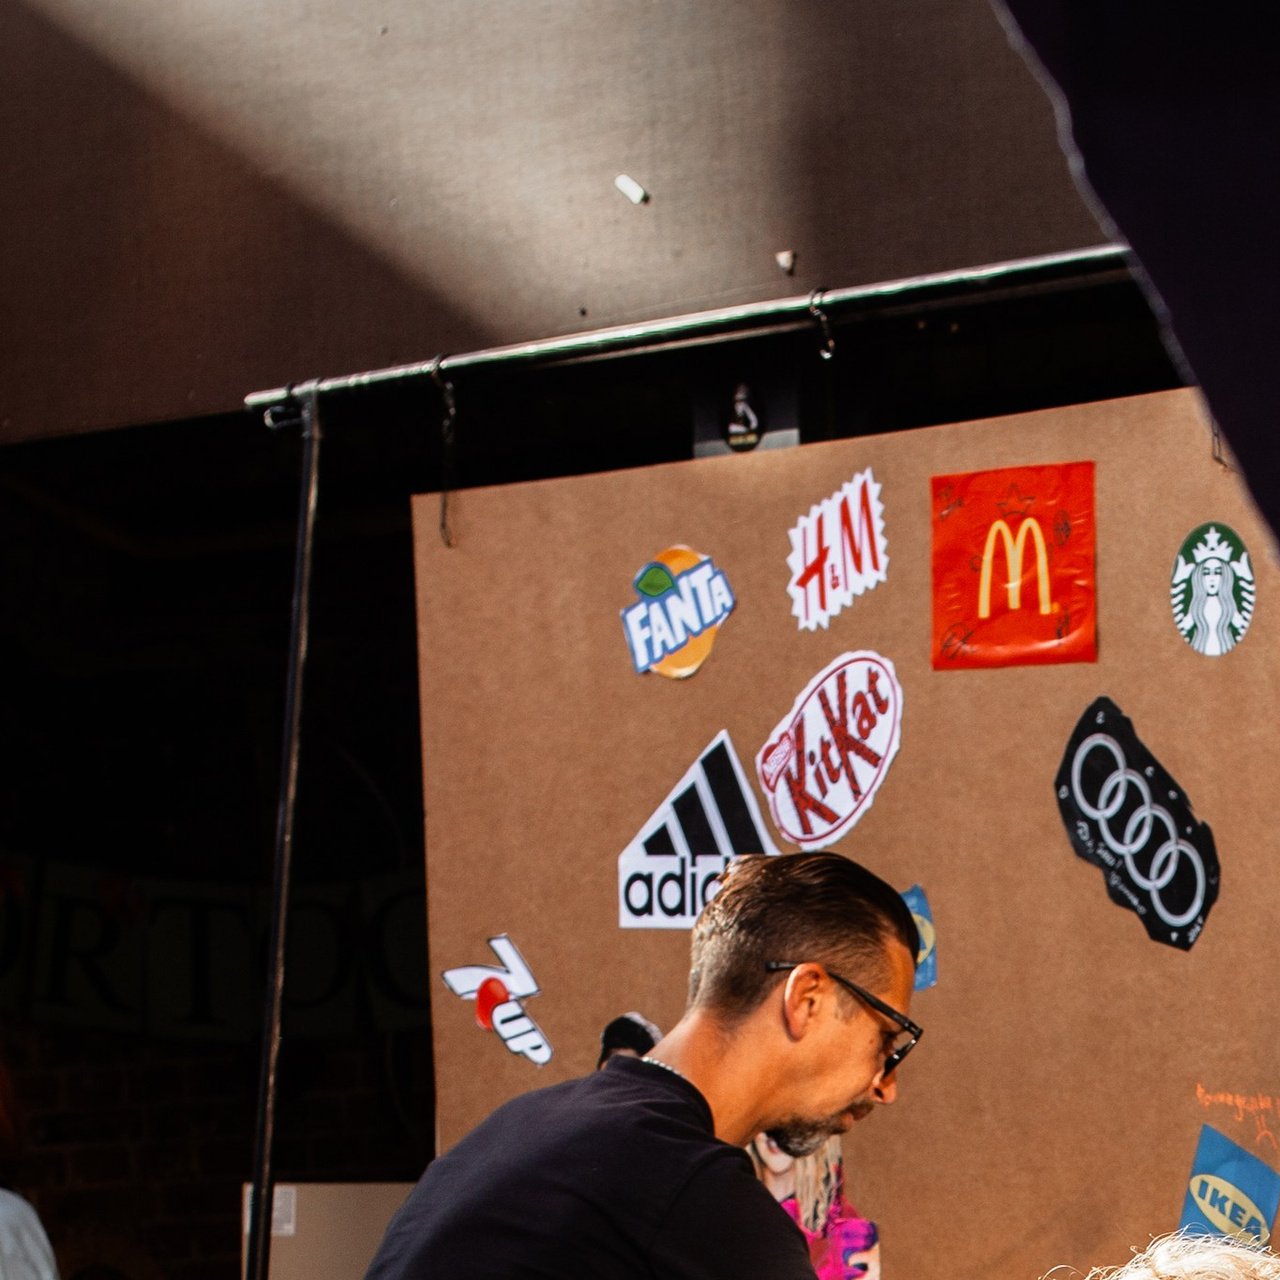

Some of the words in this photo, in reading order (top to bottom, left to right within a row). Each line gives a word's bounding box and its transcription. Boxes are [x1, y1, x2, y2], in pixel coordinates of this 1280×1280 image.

[796, 479, 880, 621] H&M
[625, 563, 734, 670] FANTA
[784, 667, 888, 835] KitKat
[1197, 1179, 1264, 1242] IKEA
